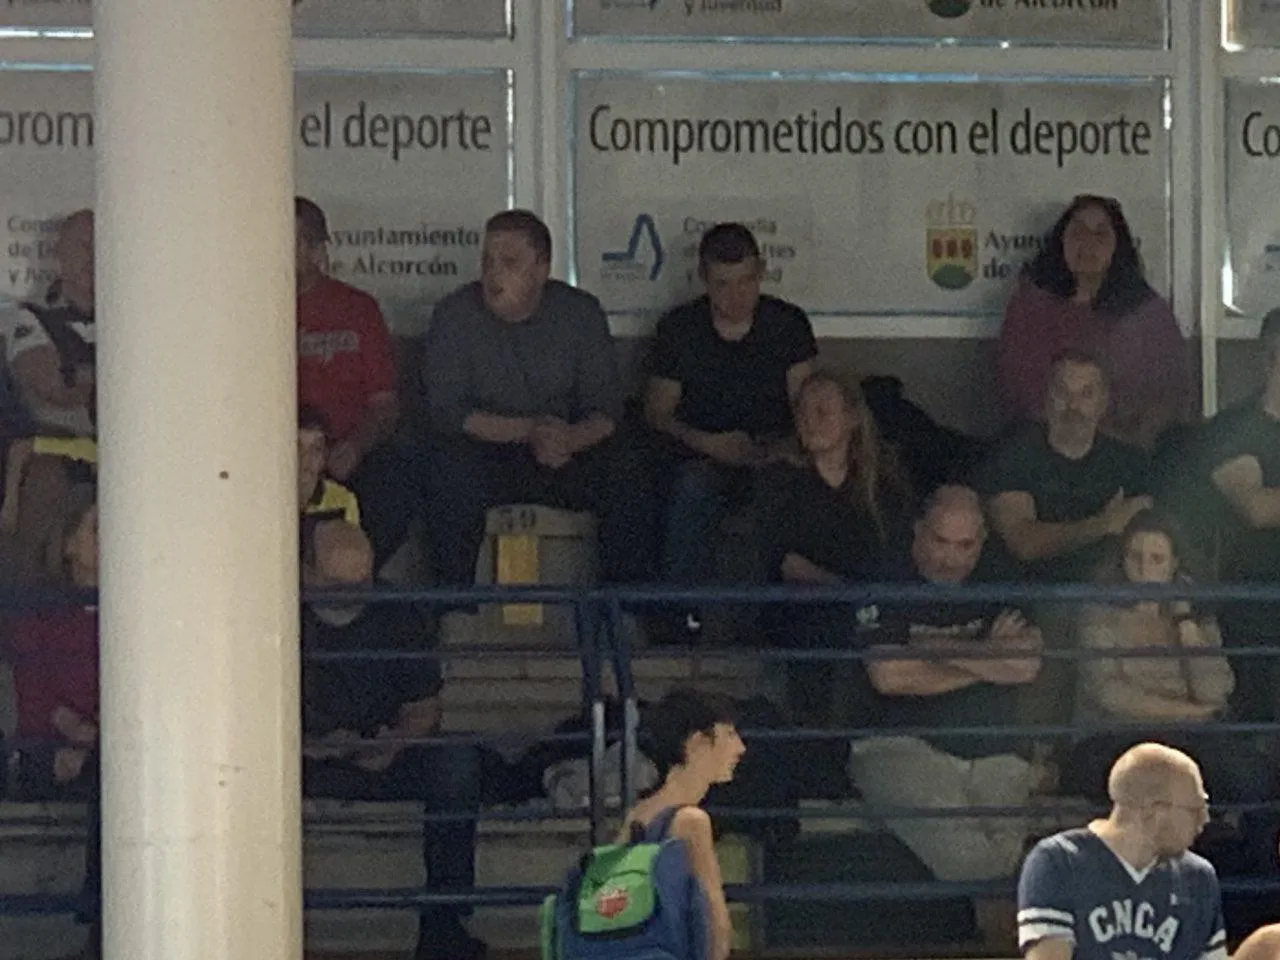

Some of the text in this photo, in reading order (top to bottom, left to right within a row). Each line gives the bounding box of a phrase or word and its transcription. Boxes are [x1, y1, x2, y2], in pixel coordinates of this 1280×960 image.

[301, 101, 491, 161] el deporte
[590, 104, 1152, 167] Comprometidos con el deporte
[329, 224, 481, 247] yuntamiento
[1088, 898, 1180, 953] CNCA
